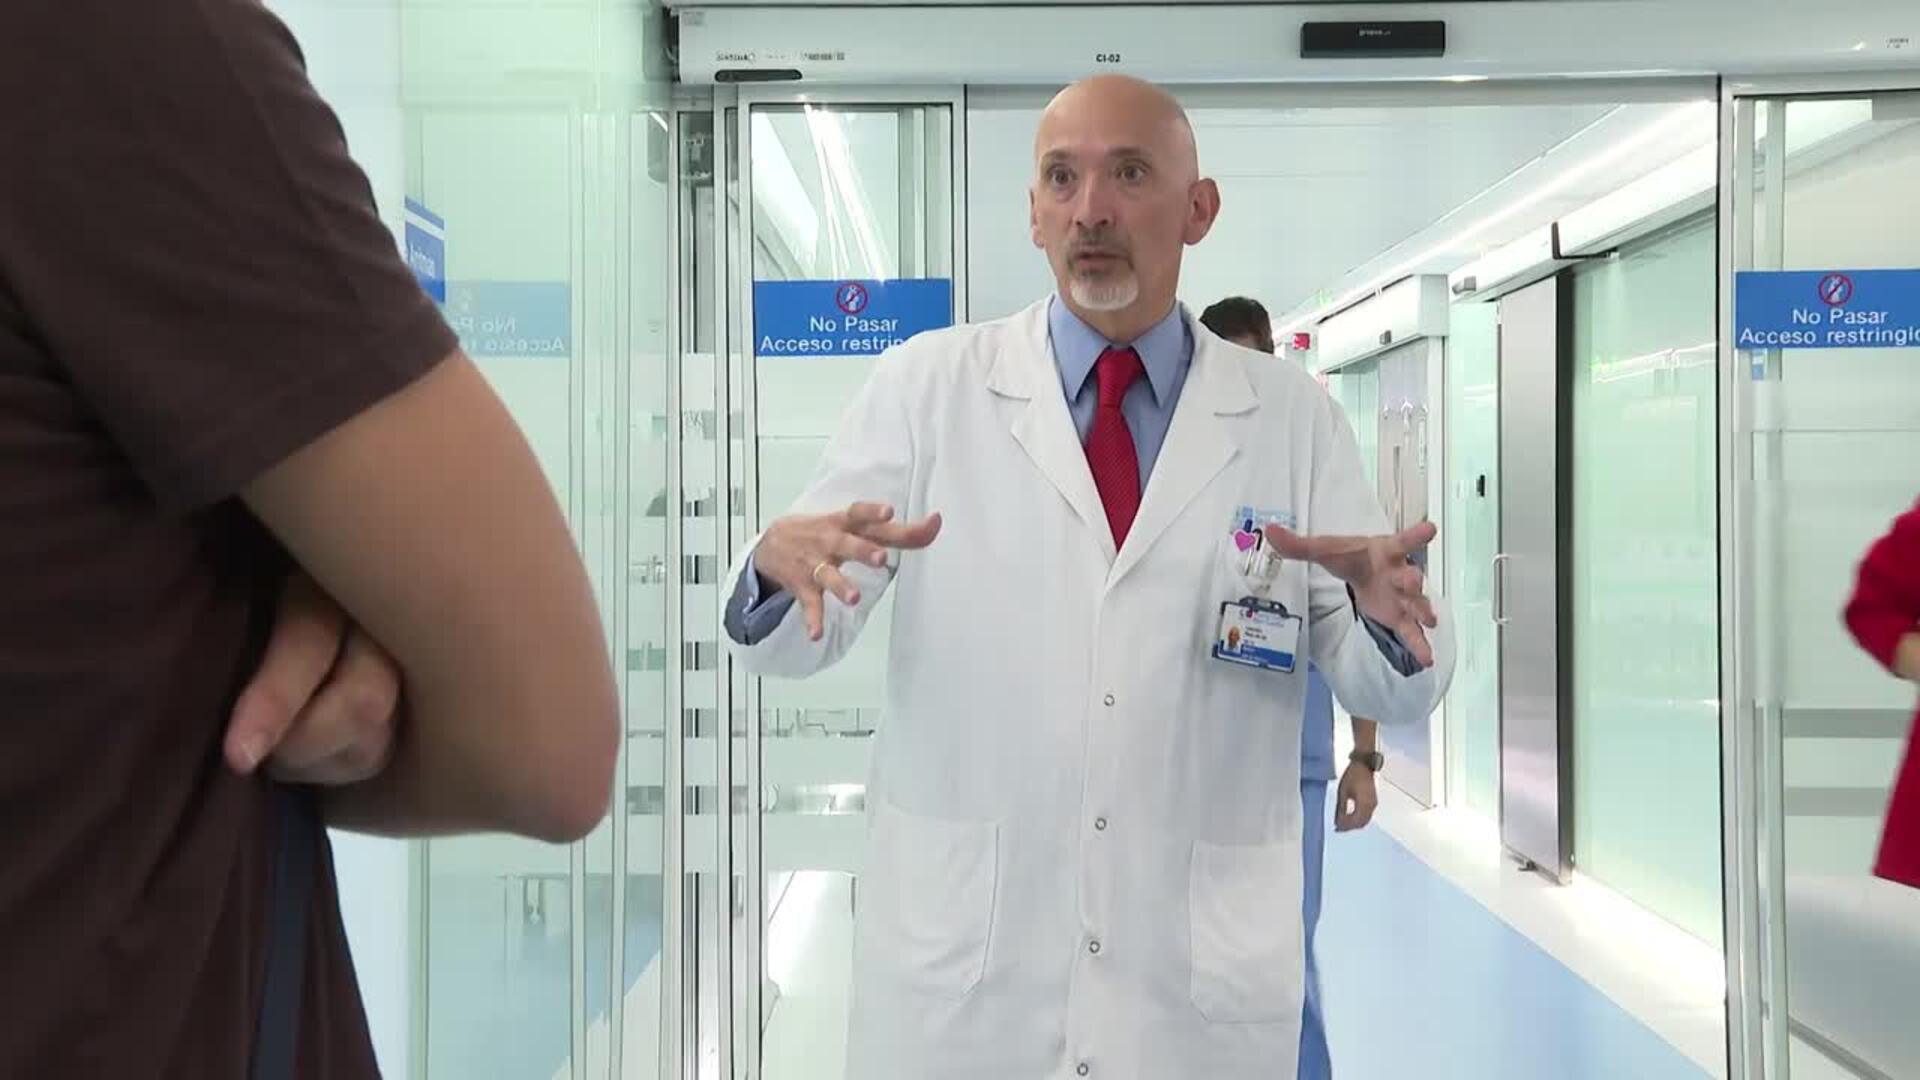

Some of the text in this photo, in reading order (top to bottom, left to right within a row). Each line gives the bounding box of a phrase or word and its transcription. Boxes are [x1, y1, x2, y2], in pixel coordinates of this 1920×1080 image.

[810, 316, 899, 332] No Pasar
[1792, 308, 1889, 325] No Pasar
[760, 335, 833, 352] Acceso
[1739, 327, 1816, 345] Acceso
